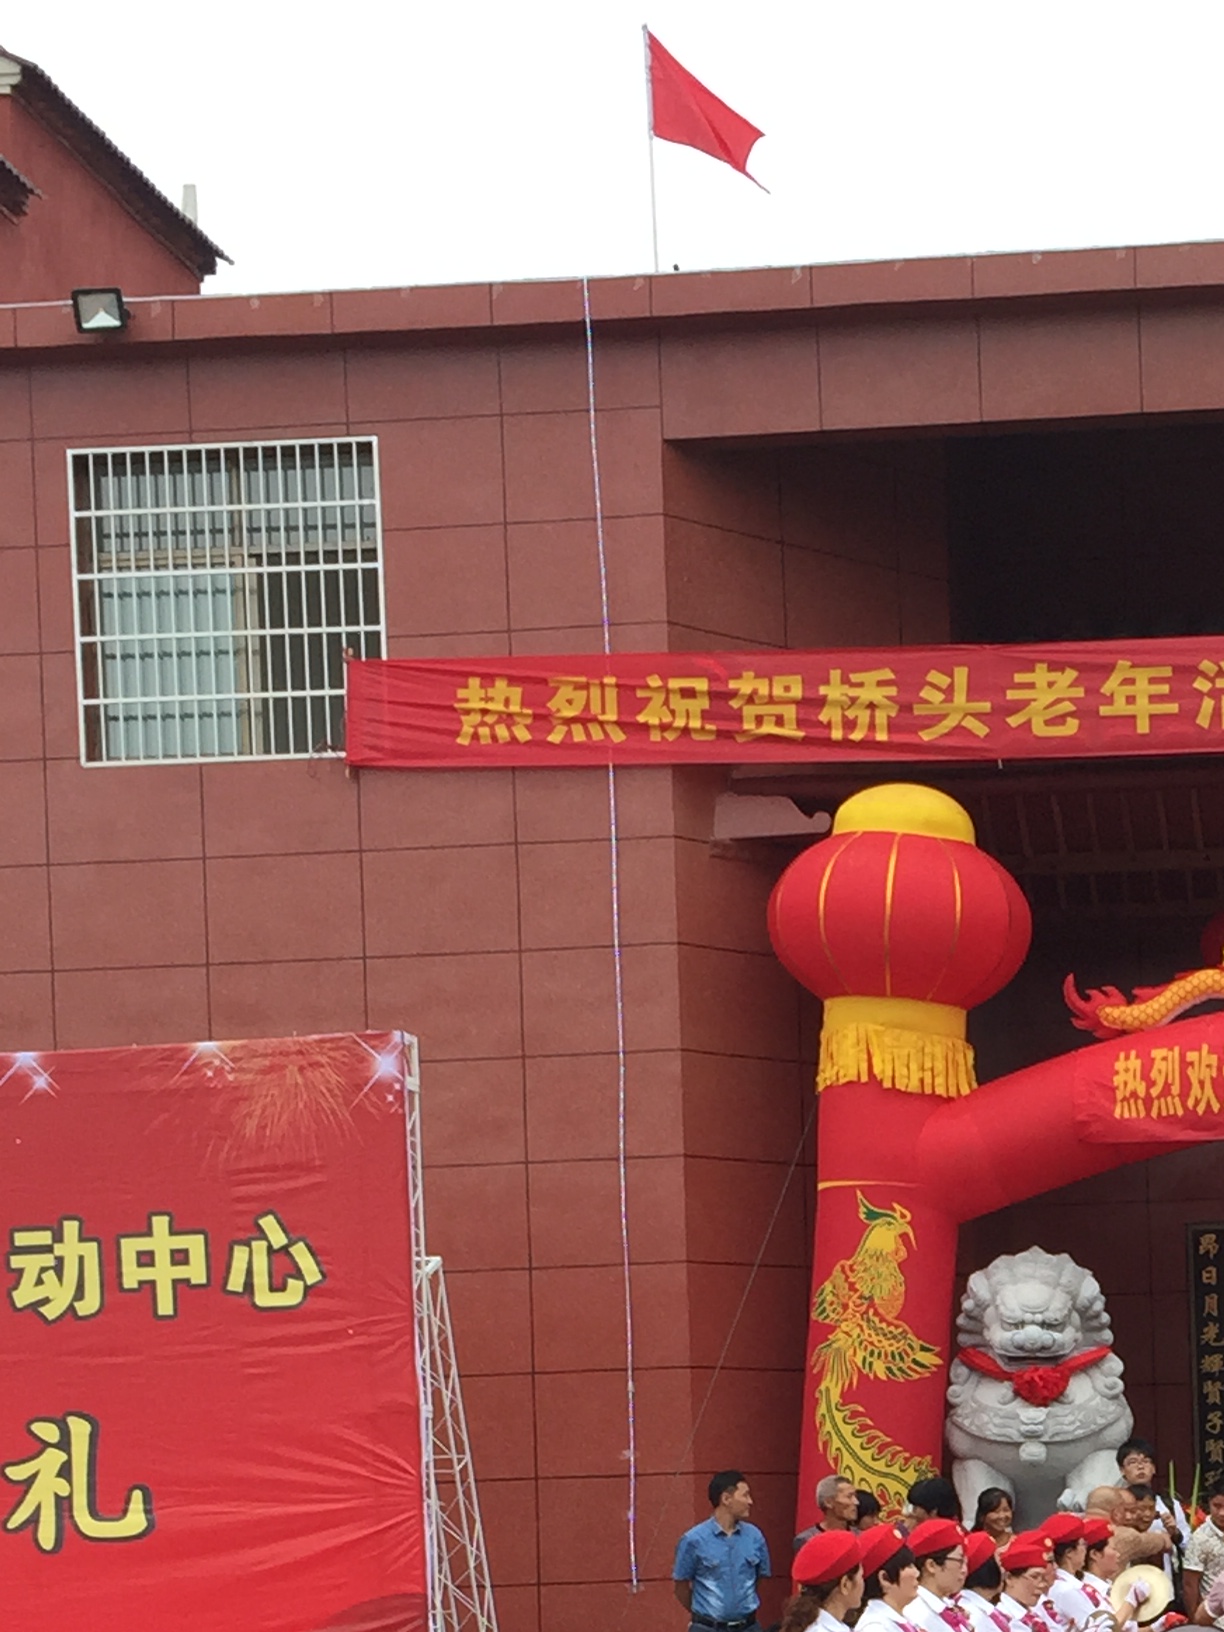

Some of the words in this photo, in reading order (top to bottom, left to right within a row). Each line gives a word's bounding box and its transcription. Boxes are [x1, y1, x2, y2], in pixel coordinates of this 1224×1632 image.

[6, 1212, 326, 1323] 动中心
[3, 1410, 154, 1555] 礼
